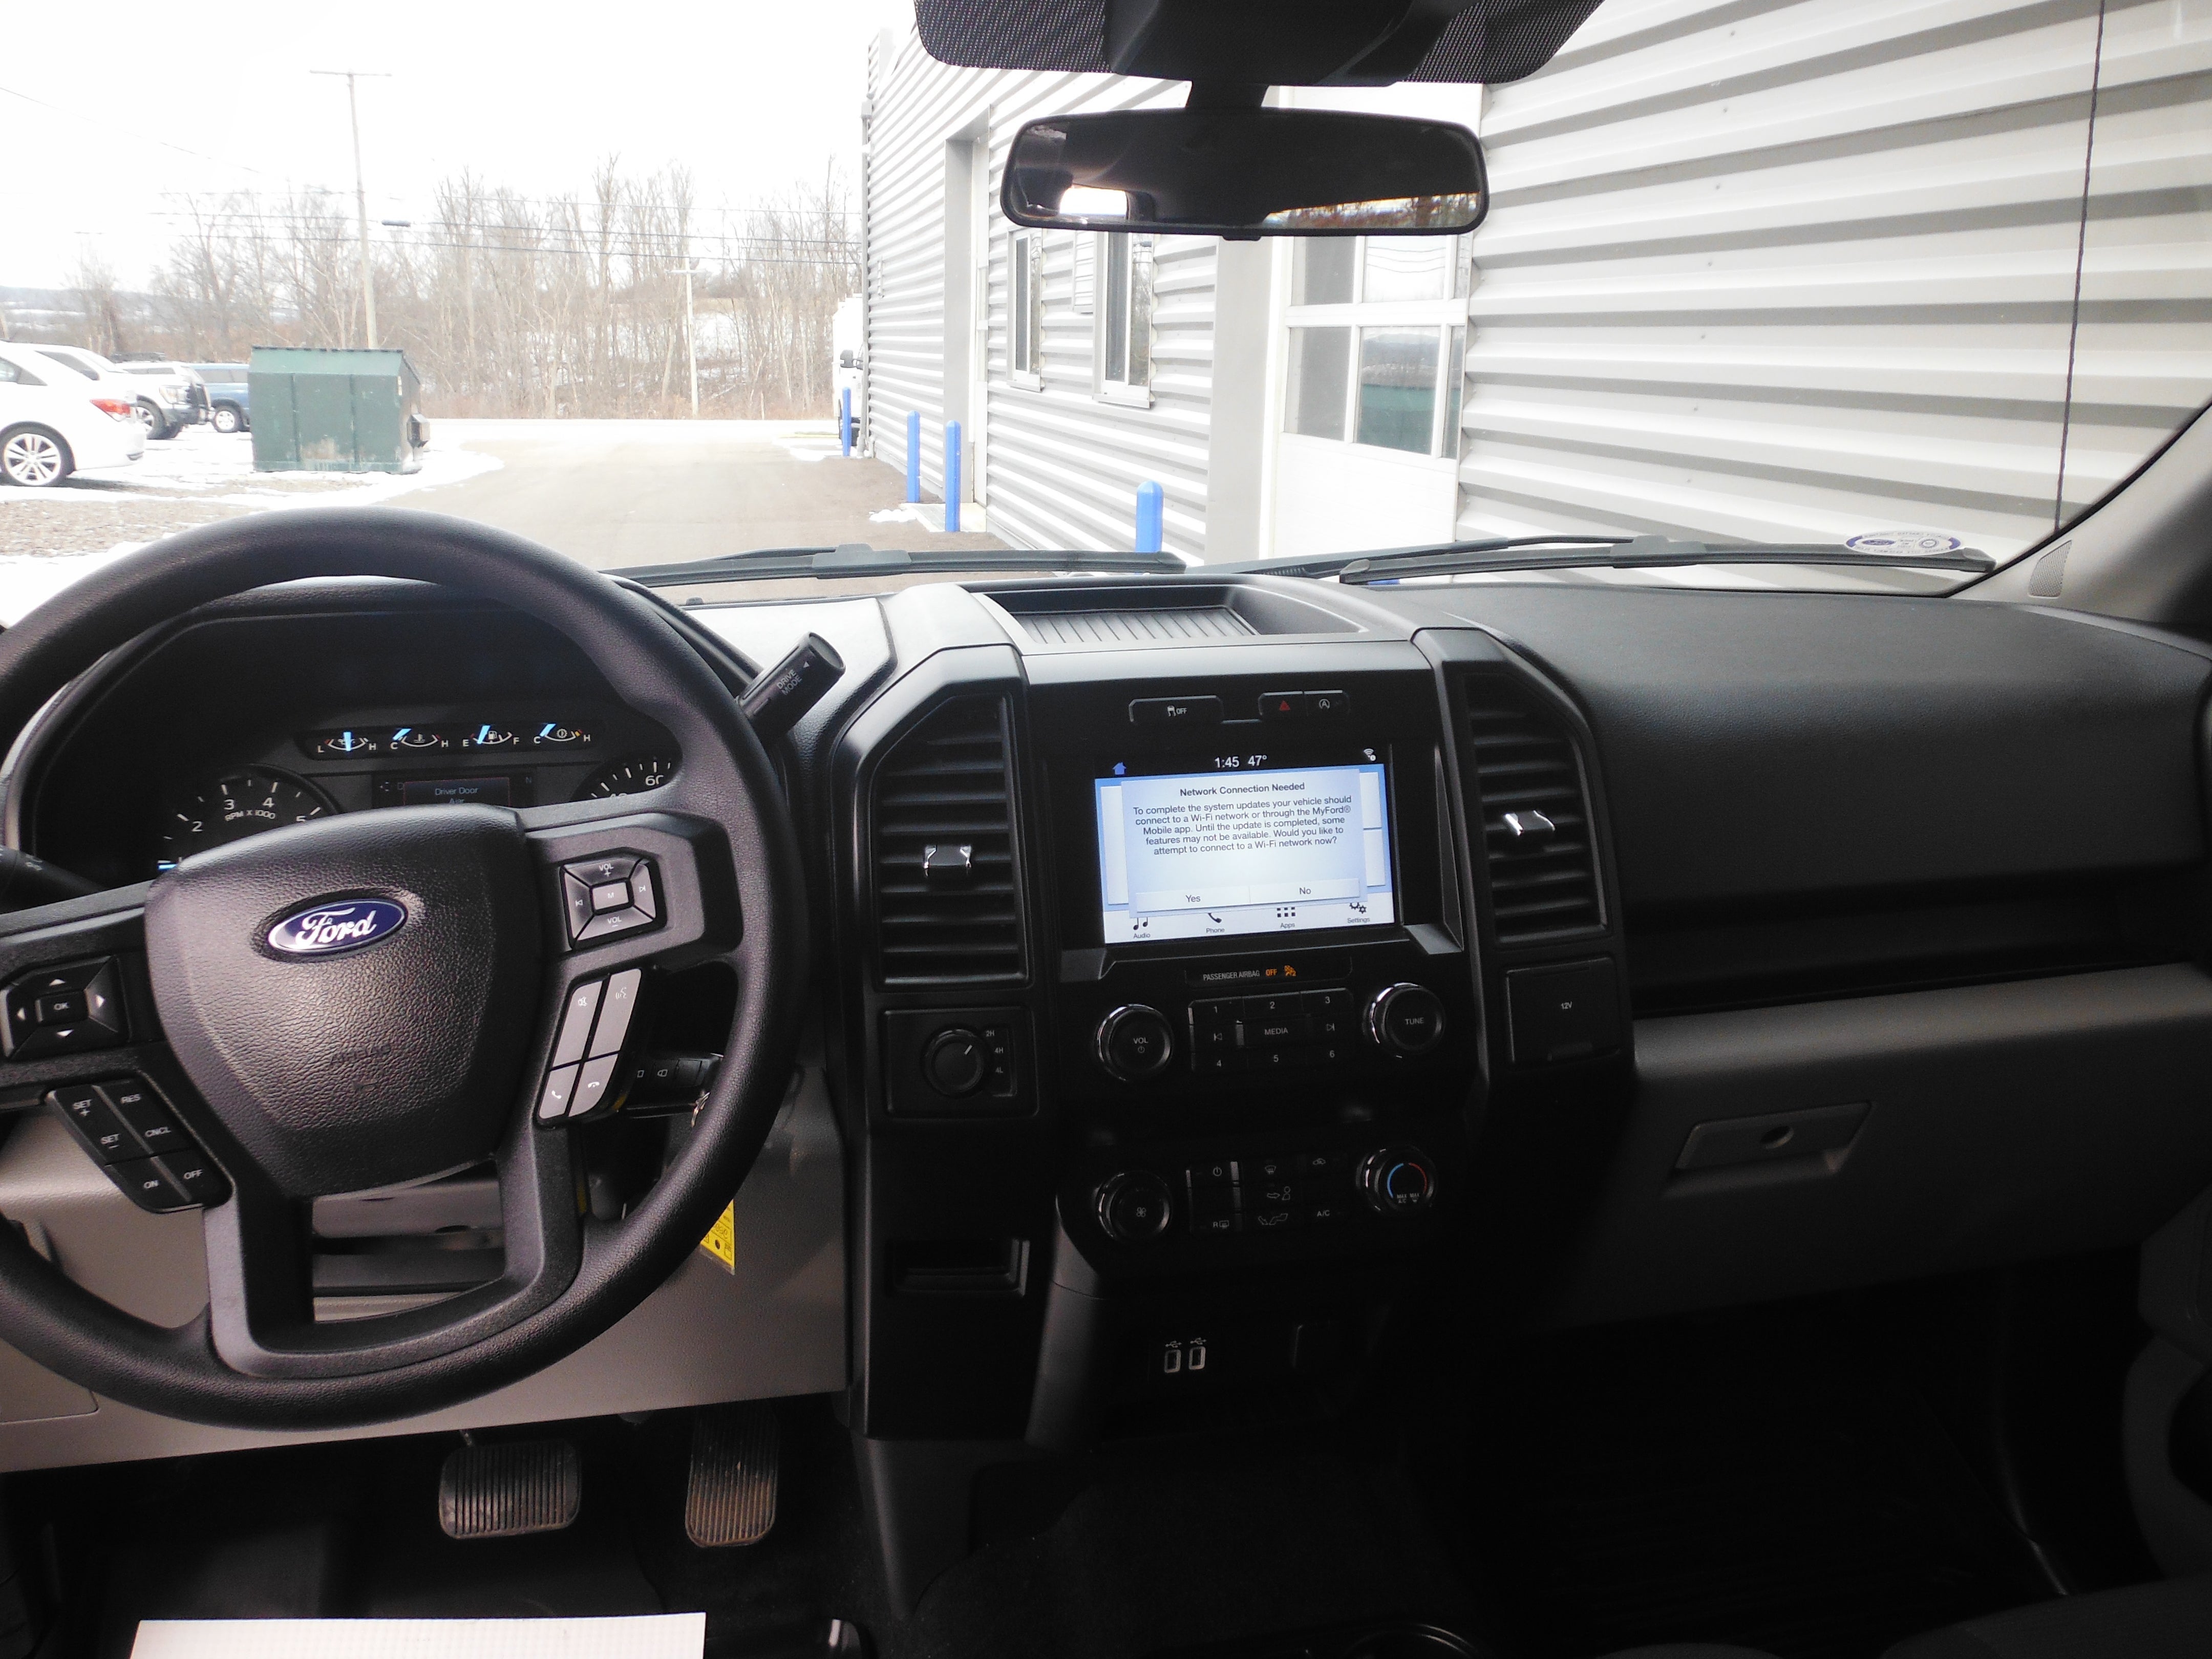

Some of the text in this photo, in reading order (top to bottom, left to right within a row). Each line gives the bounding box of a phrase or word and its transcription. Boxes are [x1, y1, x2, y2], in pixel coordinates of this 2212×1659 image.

[777, 669, 797, 689] DRIVE
[781, 674, 802, 695] MODE
[462, 738, 469, 747] E
[513, 736, 520, 745] F
[533, 736, 541, 744] C
[583, 733, 591, 741] H
[390, 741, 398, 750] C
[1215, 755, 1267, 768] 1:45 47°
[435, 788, 456, 796] Driver
[1180, 782, 1305, 797] Network Connection Needed
[223, 799, 235, 810] 3
[262, 797, 274, 809] 4
[1146, 805, 1185, 816] complete
[1188, 804, 1201, 812] the
[1204, 803, 1234, 812] system
[1237, 800, 1270, 811] updates
[1272, 799, 1291, 809] your
[1293, 797, 1322, 806] vehicle
[1324, 795, 1352, 804] should
[225, 810, 244, 821] RPM
[255, 809, 276, 820] 1000
[1135, 816, 1170, 825] connect
[1173, 815, 1181, 823] to
[1190, 813, 1213, 822] Wi-Fi
[1215, 811, 1249, 820] network
[1263, 809, 1295, 818] through
[1313, 805, 1351, 816] MyFord®
[192, 821, 204, 832] 2
[1143, 826, 1172, 835] Mobile
[1175, 826, 1192, 835] app.
[1196, 823, 1215, 832] Until
[1233, 821, 1262, 831] update
[1273, 818, 1320, 827] completed,
[1146, 837, 1180, 845] features
[1183, 836, 1200, 844] may
[1273, 829, 1299, 837] Would
[1302, 829, 1316, 838] you
[1154, 846, 1187, 855] attempt
[1200, 843, 1234, 852] connect
[1254, 840, 1277, 848] Wi-Fi
[1279, 838, 1312, 847] network
[1315, 836, 1337, 845] now?
[599, 863, 614, 871] VOL
[1299, 887, 1311, 895] No
[1185, 895, 1201, 903] Yes
[607, 916, 622, 924] VOL
[294, 907, 377, 946] Ford
[1203, 972, 1238, 981] PASSENGER
[1265, 968, 1278, 976] OFF
[53, 1002, 70, 1011] OK
[1561, 1001, 1572, 1010] 12V
[1405, 1017, 1424, 1025] TUNE
[1264, 1027, 1288, 1035] MEDIA
[73, 1099, 92, 1110] SET
[120, 1094, 142, 1104] RES
[145, 1126, 172, 1137] CNCL
[100, 1133, 120, 1144] SET
[183, 1168, 204, 1180] OFF
[143, 1179, 159, 1189] ON
